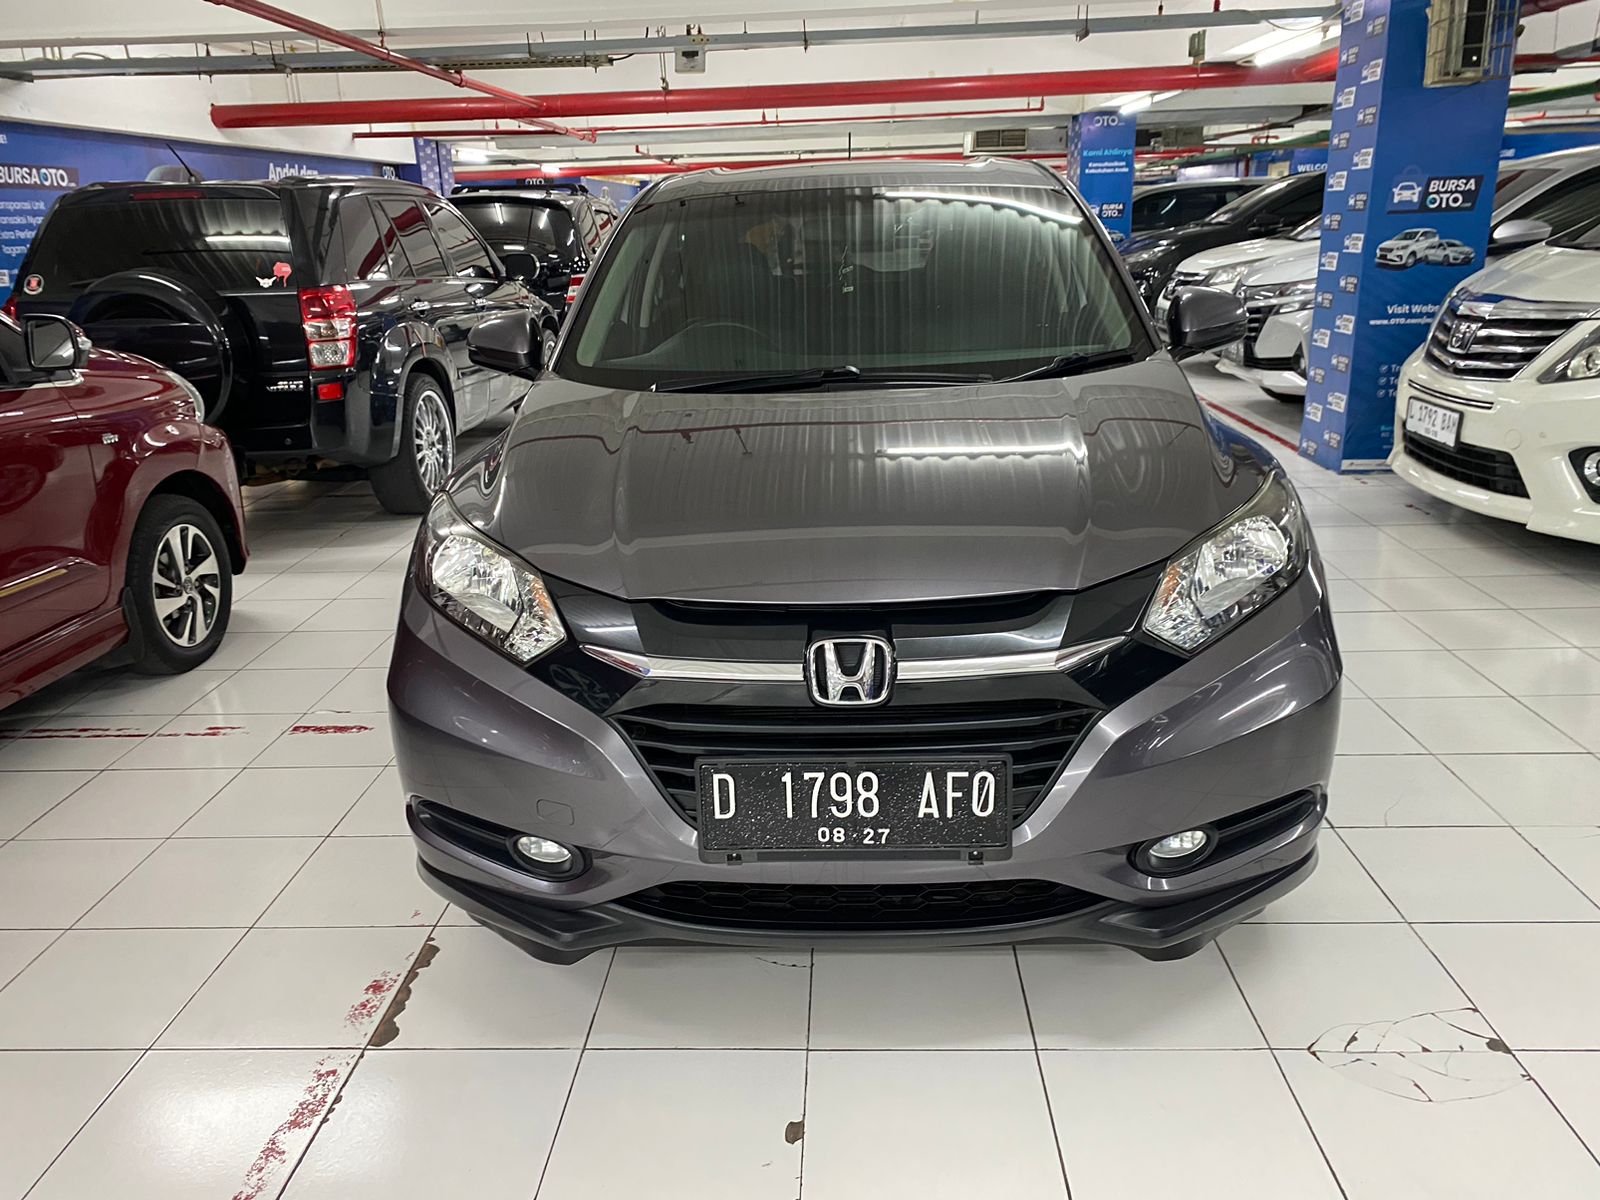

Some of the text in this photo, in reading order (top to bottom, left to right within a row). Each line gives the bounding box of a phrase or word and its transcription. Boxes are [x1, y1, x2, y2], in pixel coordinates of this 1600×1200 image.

[1428, 178, 1476, 193] BURSA
[1102, 203, 1124, 211] BURSA
[1387, 304, 1410, 314] Visit
[712, 773, 736, 820] D
[781, 771, 880, 819] 1798
